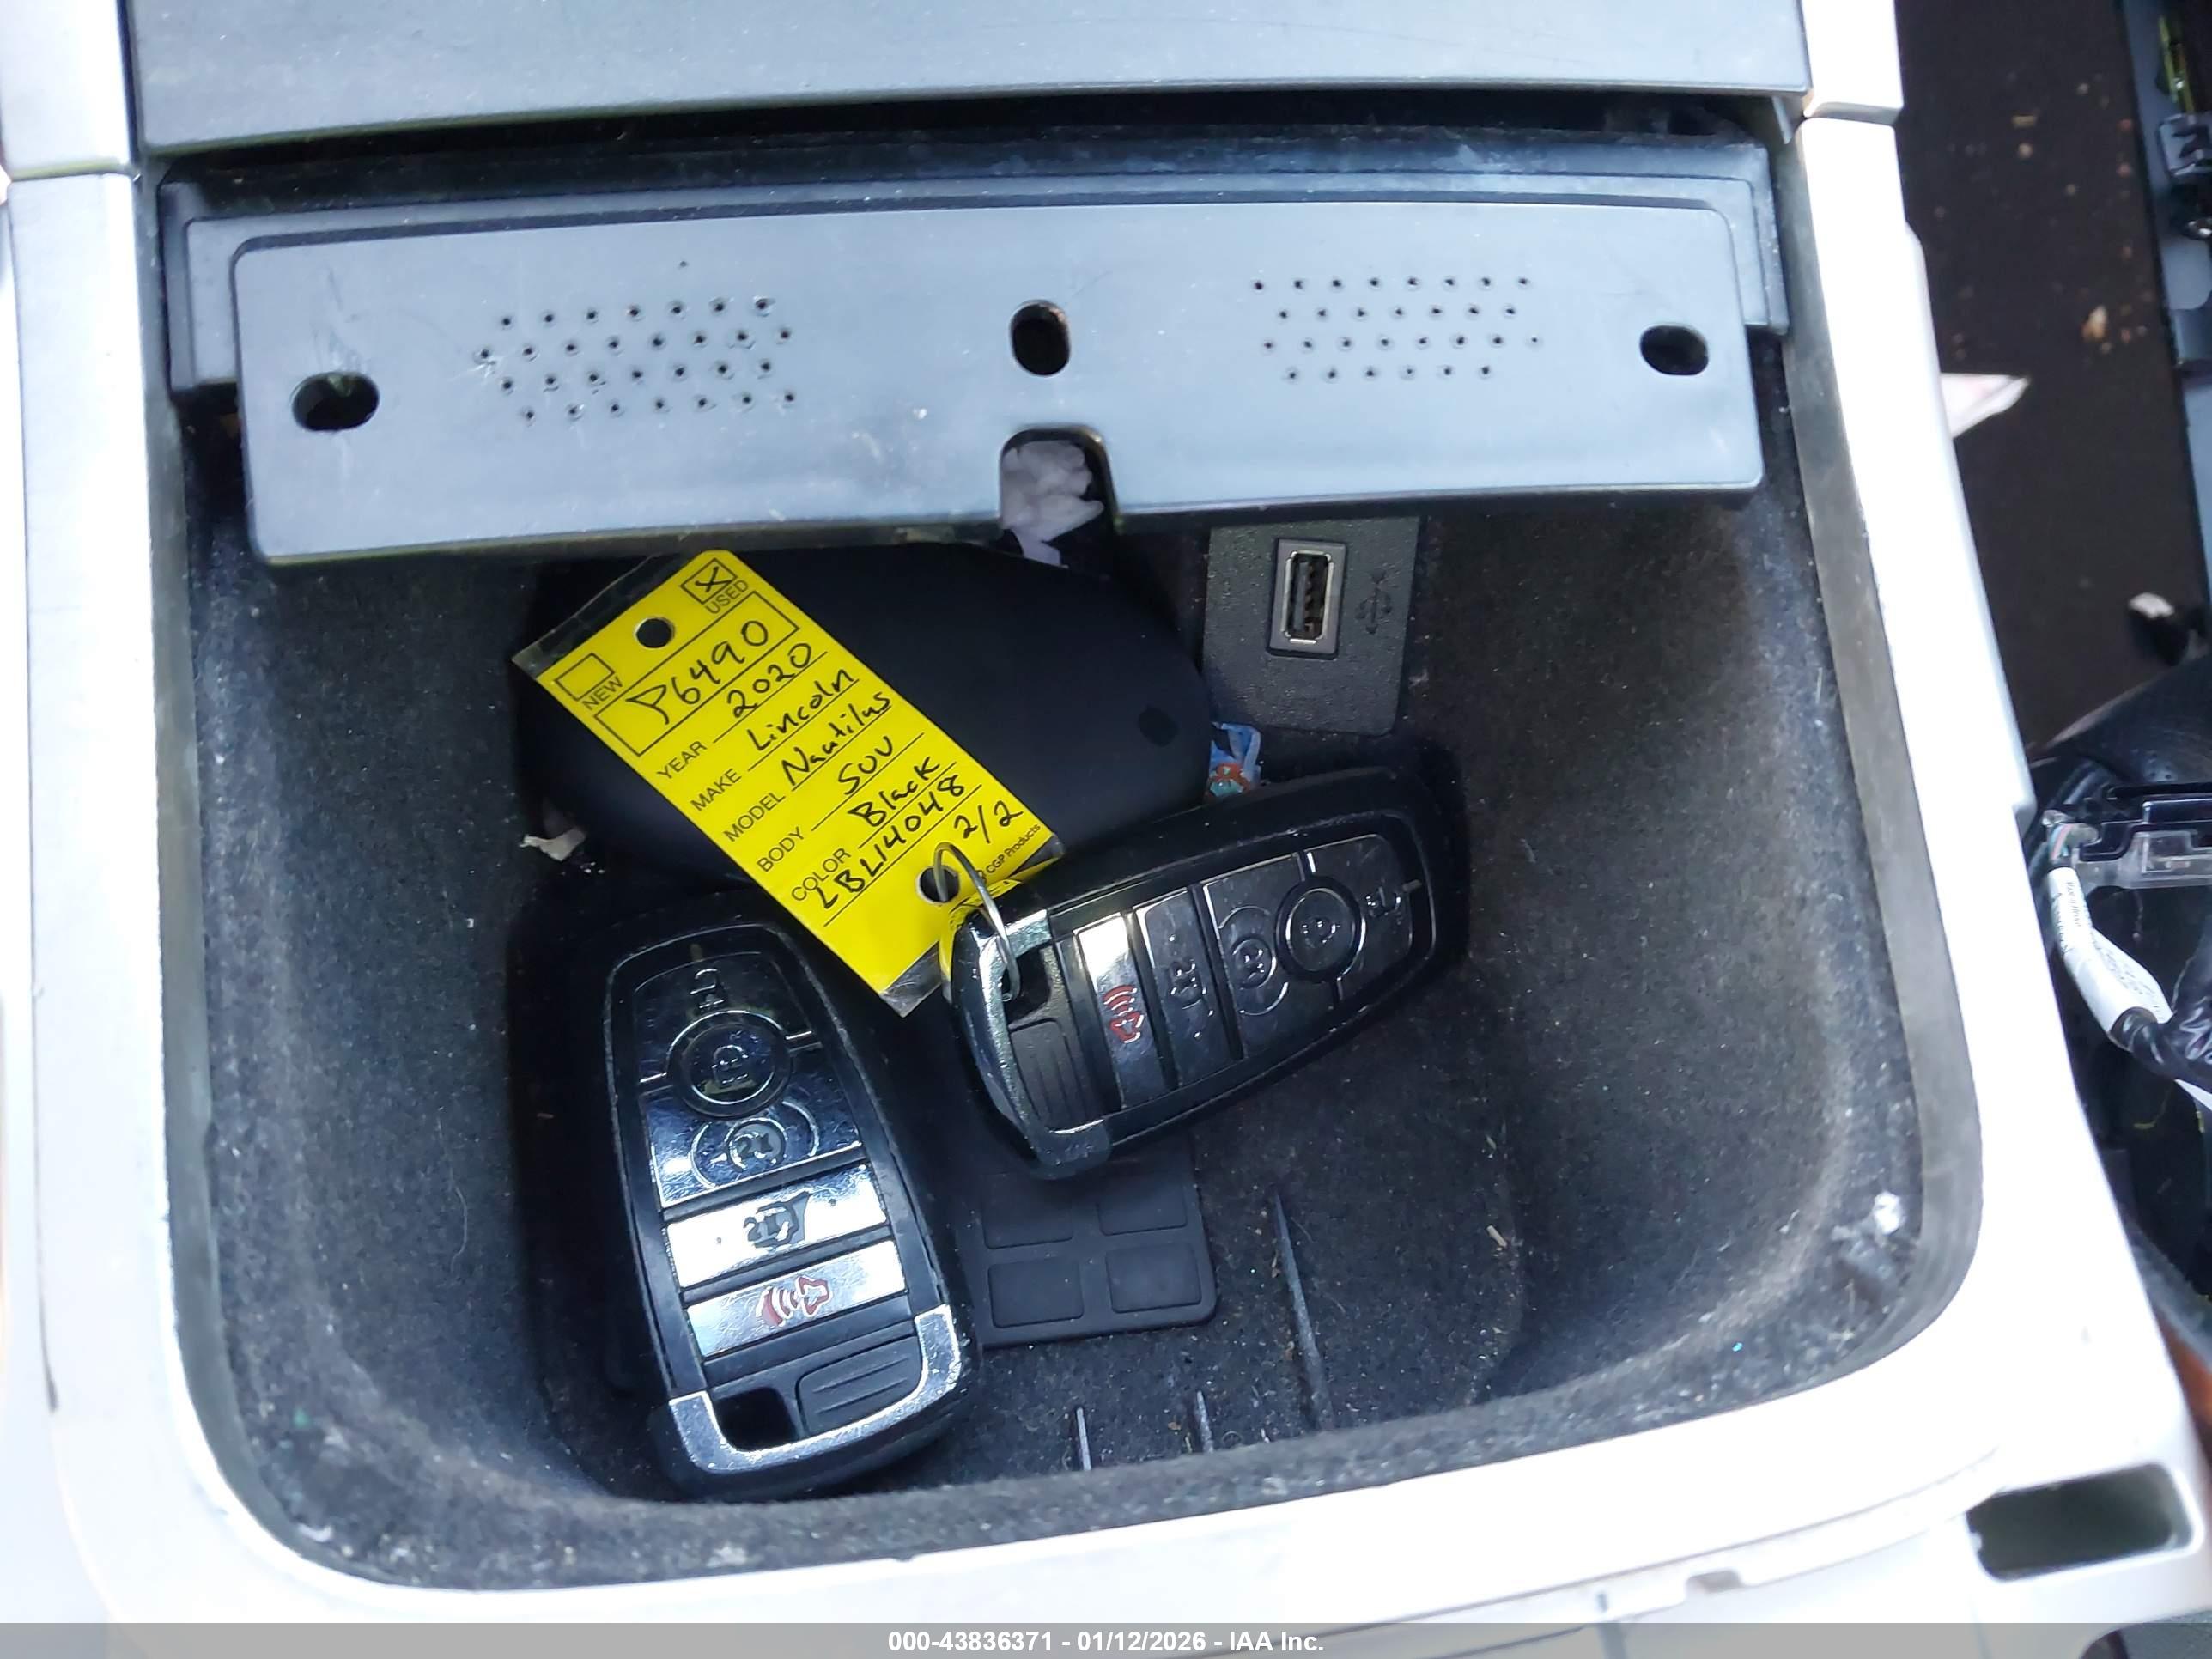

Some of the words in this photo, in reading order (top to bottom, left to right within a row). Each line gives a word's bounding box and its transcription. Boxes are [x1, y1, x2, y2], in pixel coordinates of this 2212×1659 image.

[704, 579, 749, 615] USED
[582, 676, 623, 711] NEW
[625, 620, 769, 725] P6490
[726, 642, 811, 718] 2020
[746, 669, 854, 751] Lincoln
[657, 741, 708, 779] YEAR
[781, 691, 890, 786] Nautilus
[690, 768, 742, 811] MAKE
[838, 736, 893, 795] SUV
[723, 792, 786, 842] MODEL
[816, 775, 964, 908] LBL14048
[954, 800, 1024, 844] 2/2
[757, 826, 804, 872] BODY
[986, 854, 1006, 874] CGP
[1004, 824, 1041, 857] Products
[792, 848, 851, 902] COLOR
